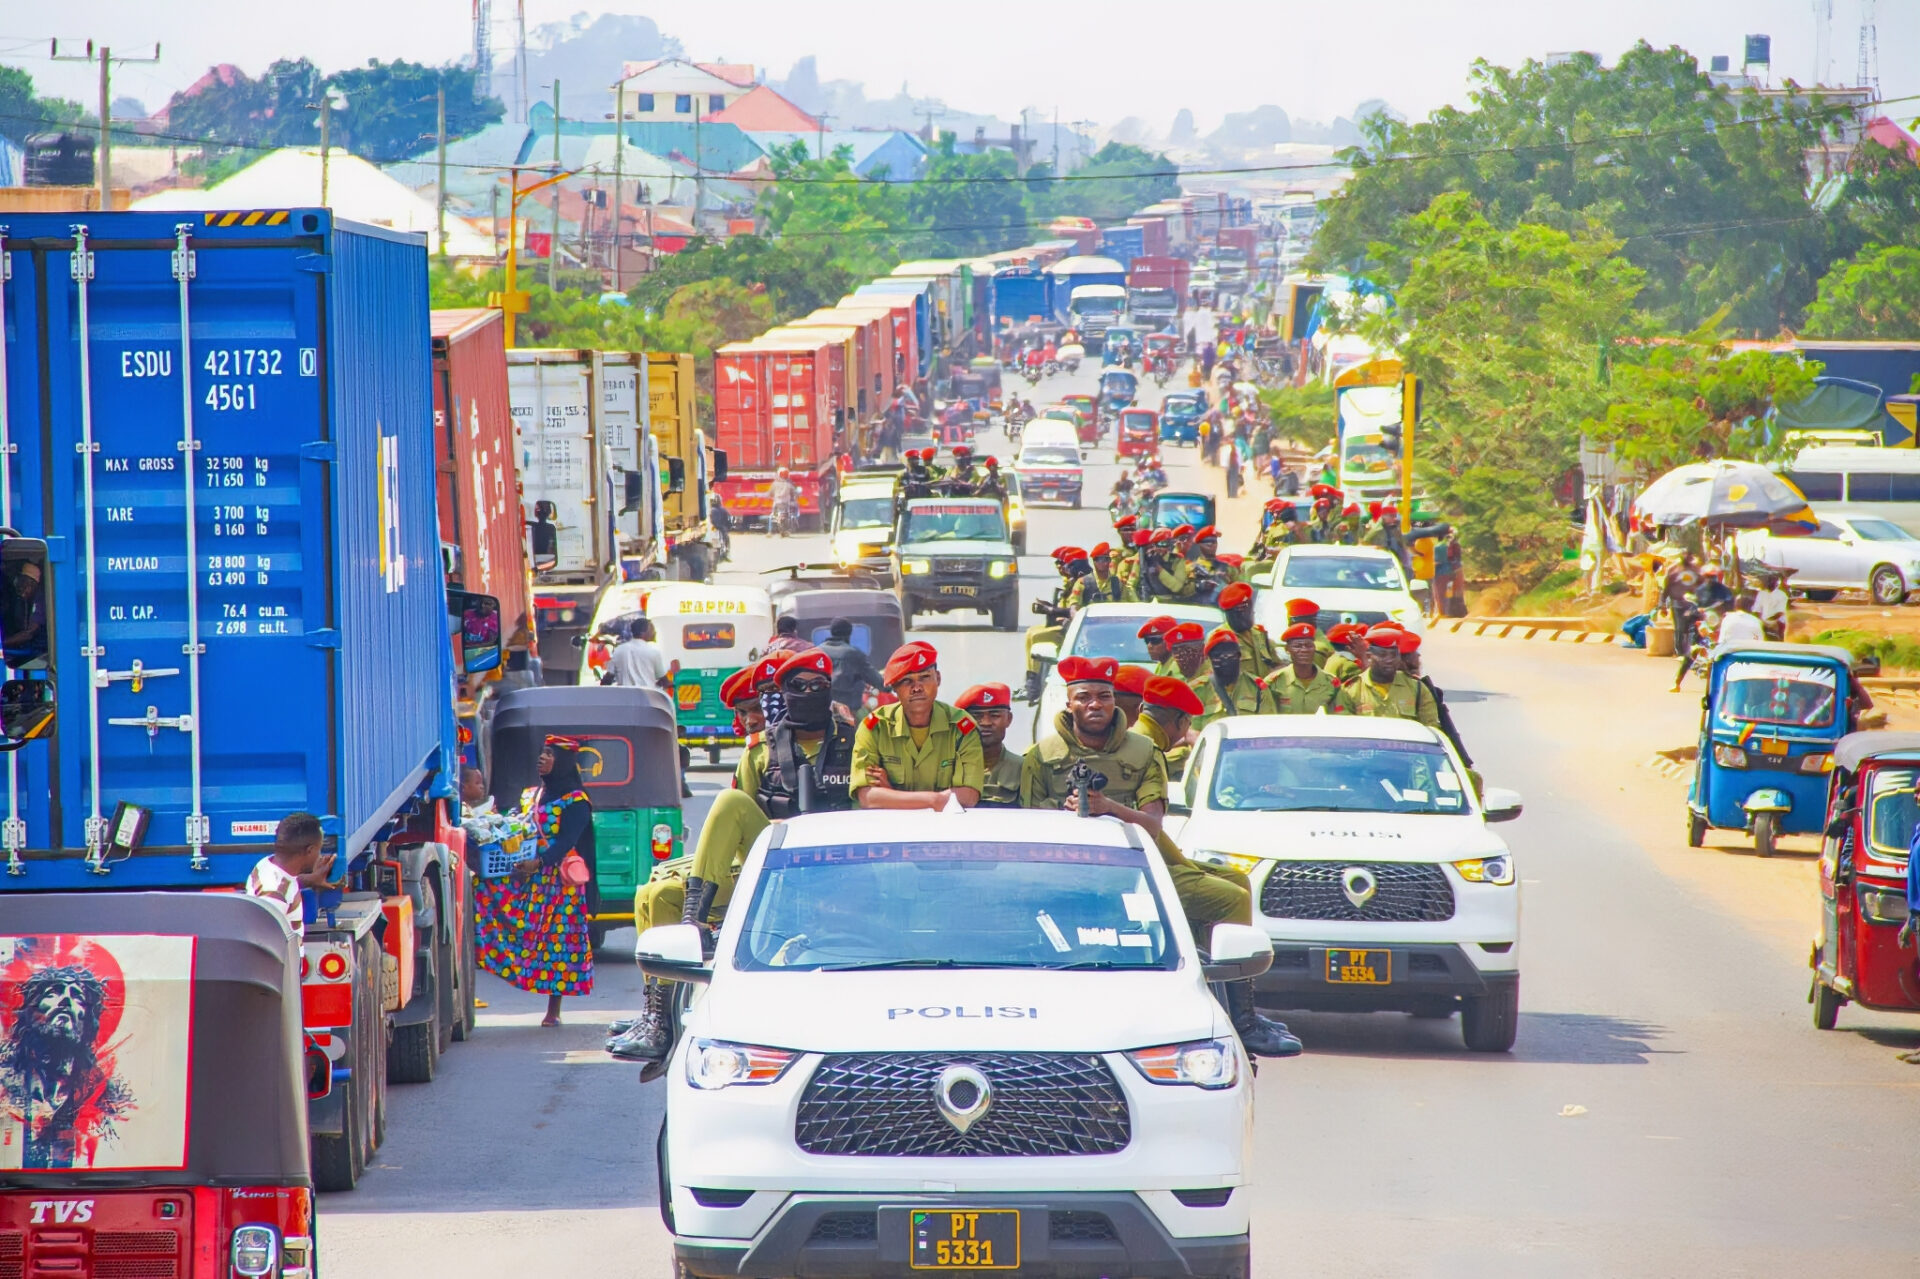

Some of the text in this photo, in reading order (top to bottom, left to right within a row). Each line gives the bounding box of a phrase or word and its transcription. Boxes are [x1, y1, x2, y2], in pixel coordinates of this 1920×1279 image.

[121, 350, 171, 377] ESDU
[204, 350, 283, 376] 421732
[205, 384, 256, 410] 45G1
[105, 456, 268, 472] MAX GROSS 32 500 kg
[207, 473, 266, 487] 71 650 lb
[107, 506, 269, 522] TARE 3 700 kg
[226, 523, 245, 536] 160
[257, 523, 267, 535] lb
[108, 555, 270, 571] PAYLOAD 28 800 kg
[209, 572, 268, 585] 63 490 lb
[110, 604, 288, 620] CU. CAP. 76.4 cu.m.
[216, 621, 288, 635] 2 698 cu.ft.
[822, 774, 851, 785] POLIC
[1310, 830, 1402, 839] POLISI
[793, 844, 890, 863] FIELD
[888, 1006, 1038, 1020] POLISI
[29, 1200, 94, 1223] TVS
[950, 1213, 979, 1239] PT
[936, 1239, 994, 1265] 5331
